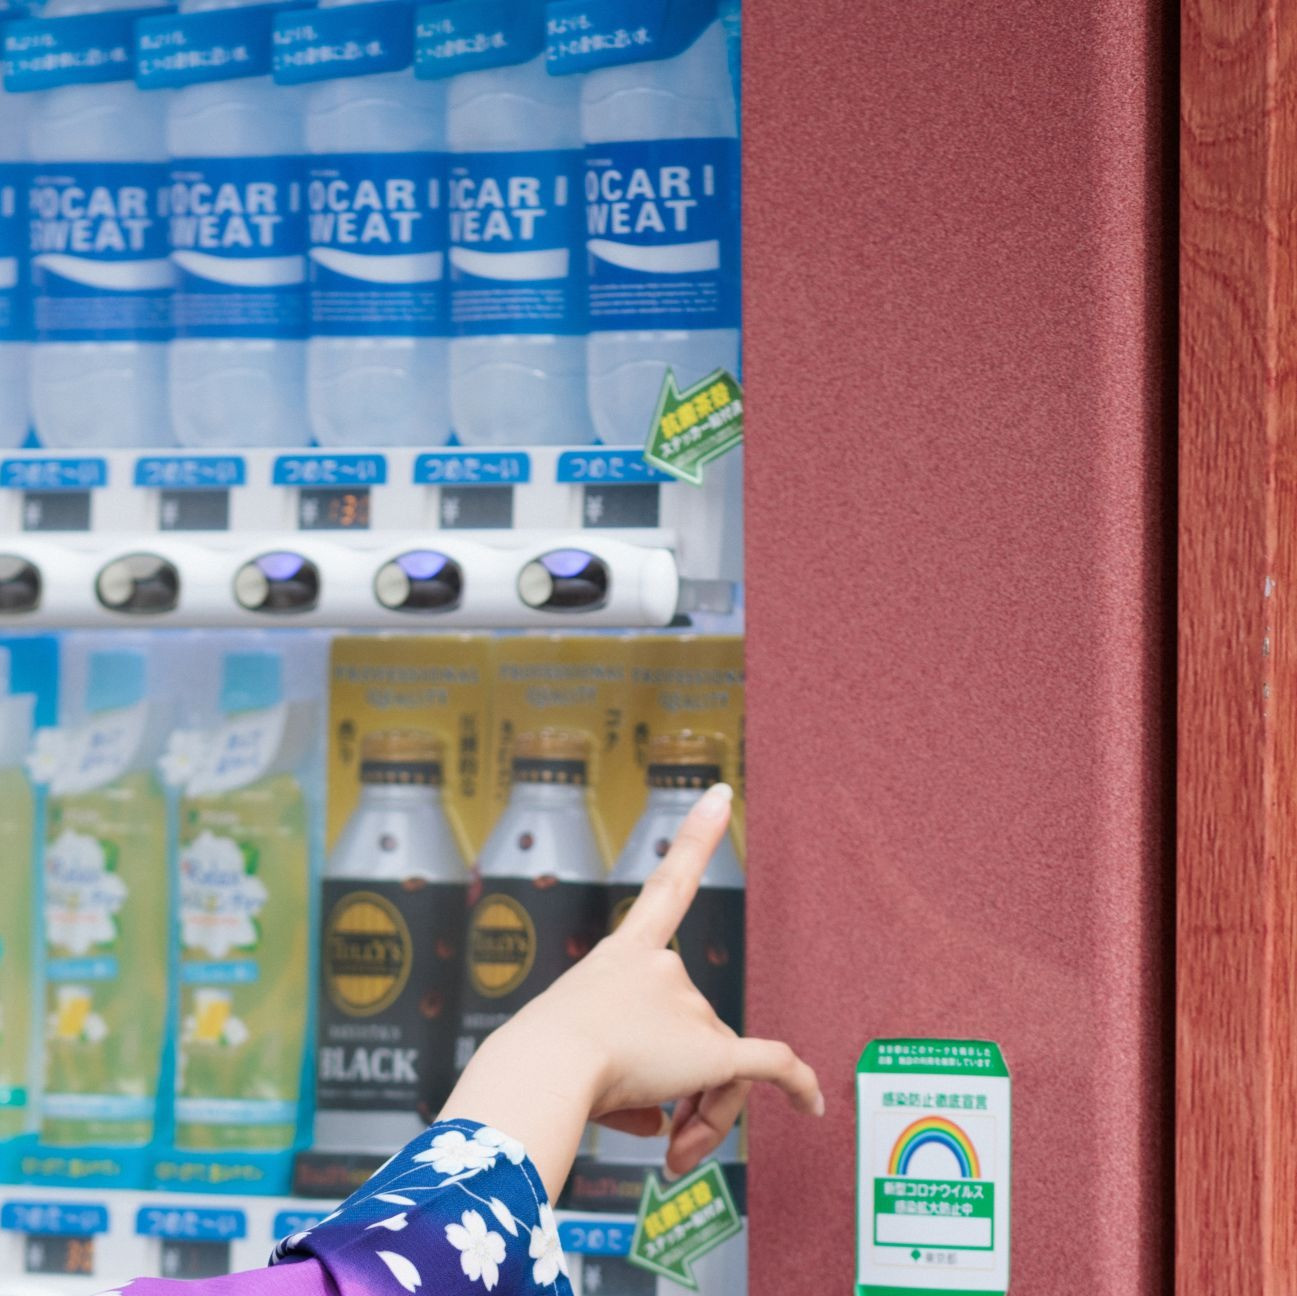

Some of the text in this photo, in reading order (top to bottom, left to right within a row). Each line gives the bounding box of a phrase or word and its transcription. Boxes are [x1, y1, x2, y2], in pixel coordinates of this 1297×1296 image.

[319, 1046, 419, 1083] BLACK
[884, 1181, 984, 1199] 新型コロナウイルス
